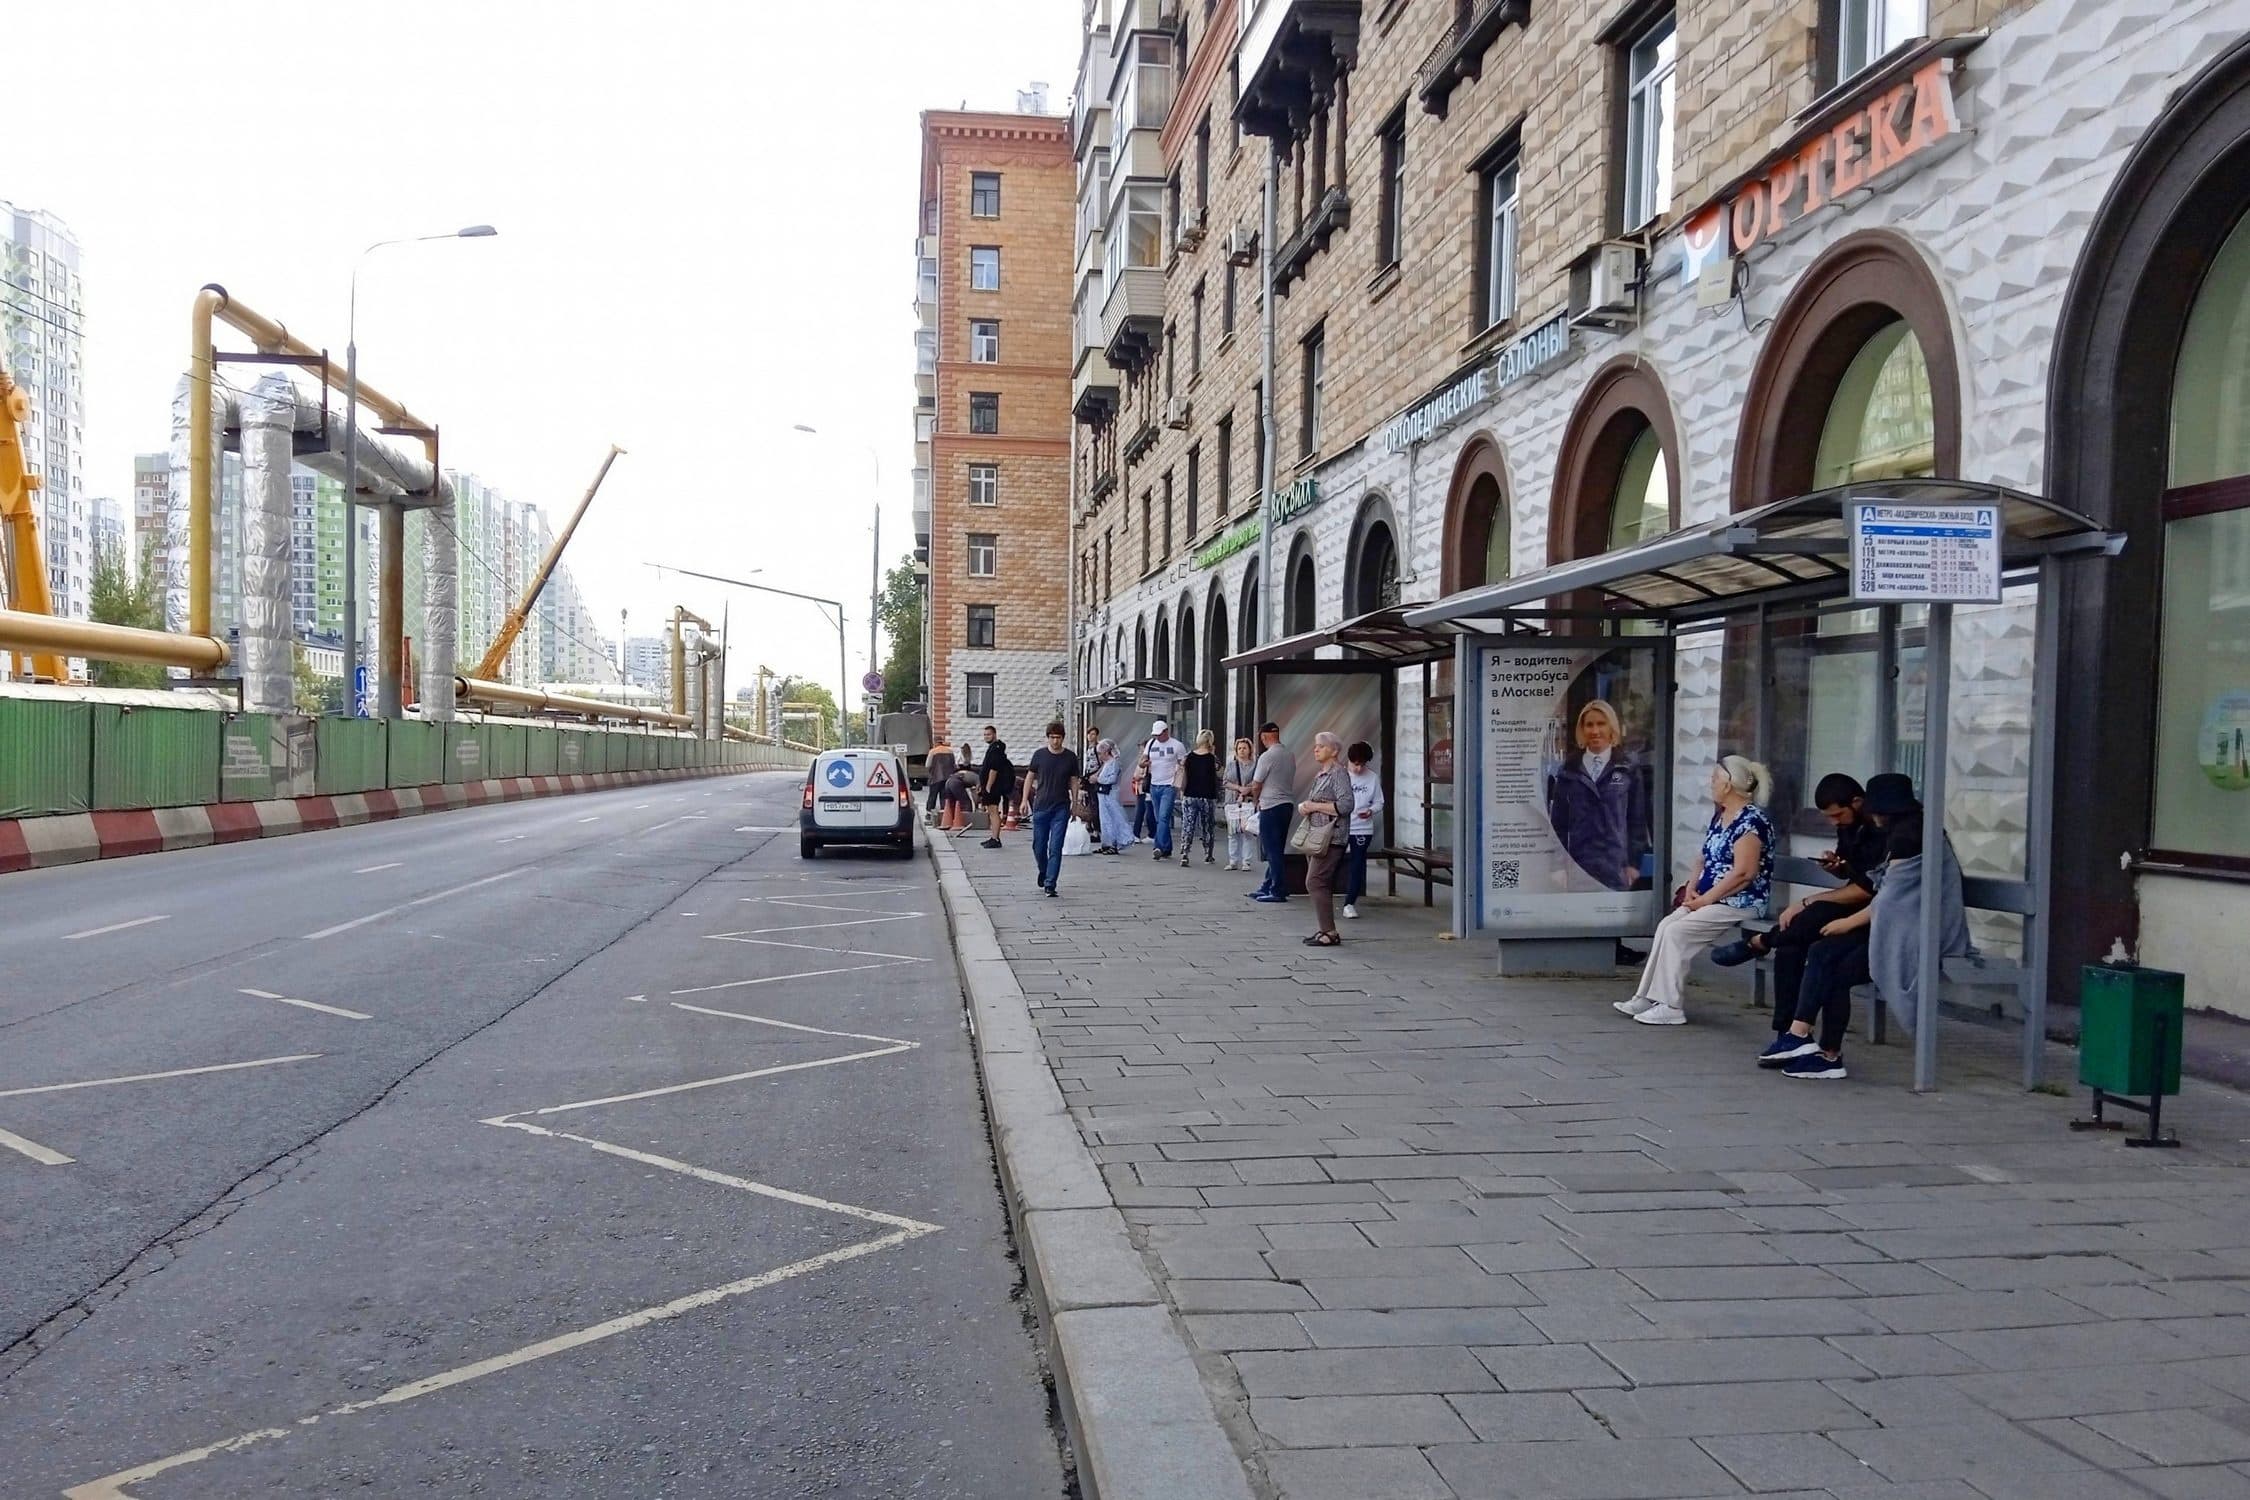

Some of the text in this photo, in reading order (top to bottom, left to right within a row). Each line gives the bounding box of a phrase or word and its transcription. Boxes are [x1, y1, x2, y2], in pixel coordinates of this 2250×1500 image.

[1733, 57, 1958, 250] ОРТЕКА
[1385, 317, 1568, 452] ОРТОПЕДИЧЕСКИЕ САЛОНЫ
[1862, 558, 1875, 568] 121
[1491, 655, 1500, 666] Я
[1514, 656, 1573, 667] водитель
[1491, 670, 1569, 683] электробуса
[1491, 685, 1555, 697] в Москве!
